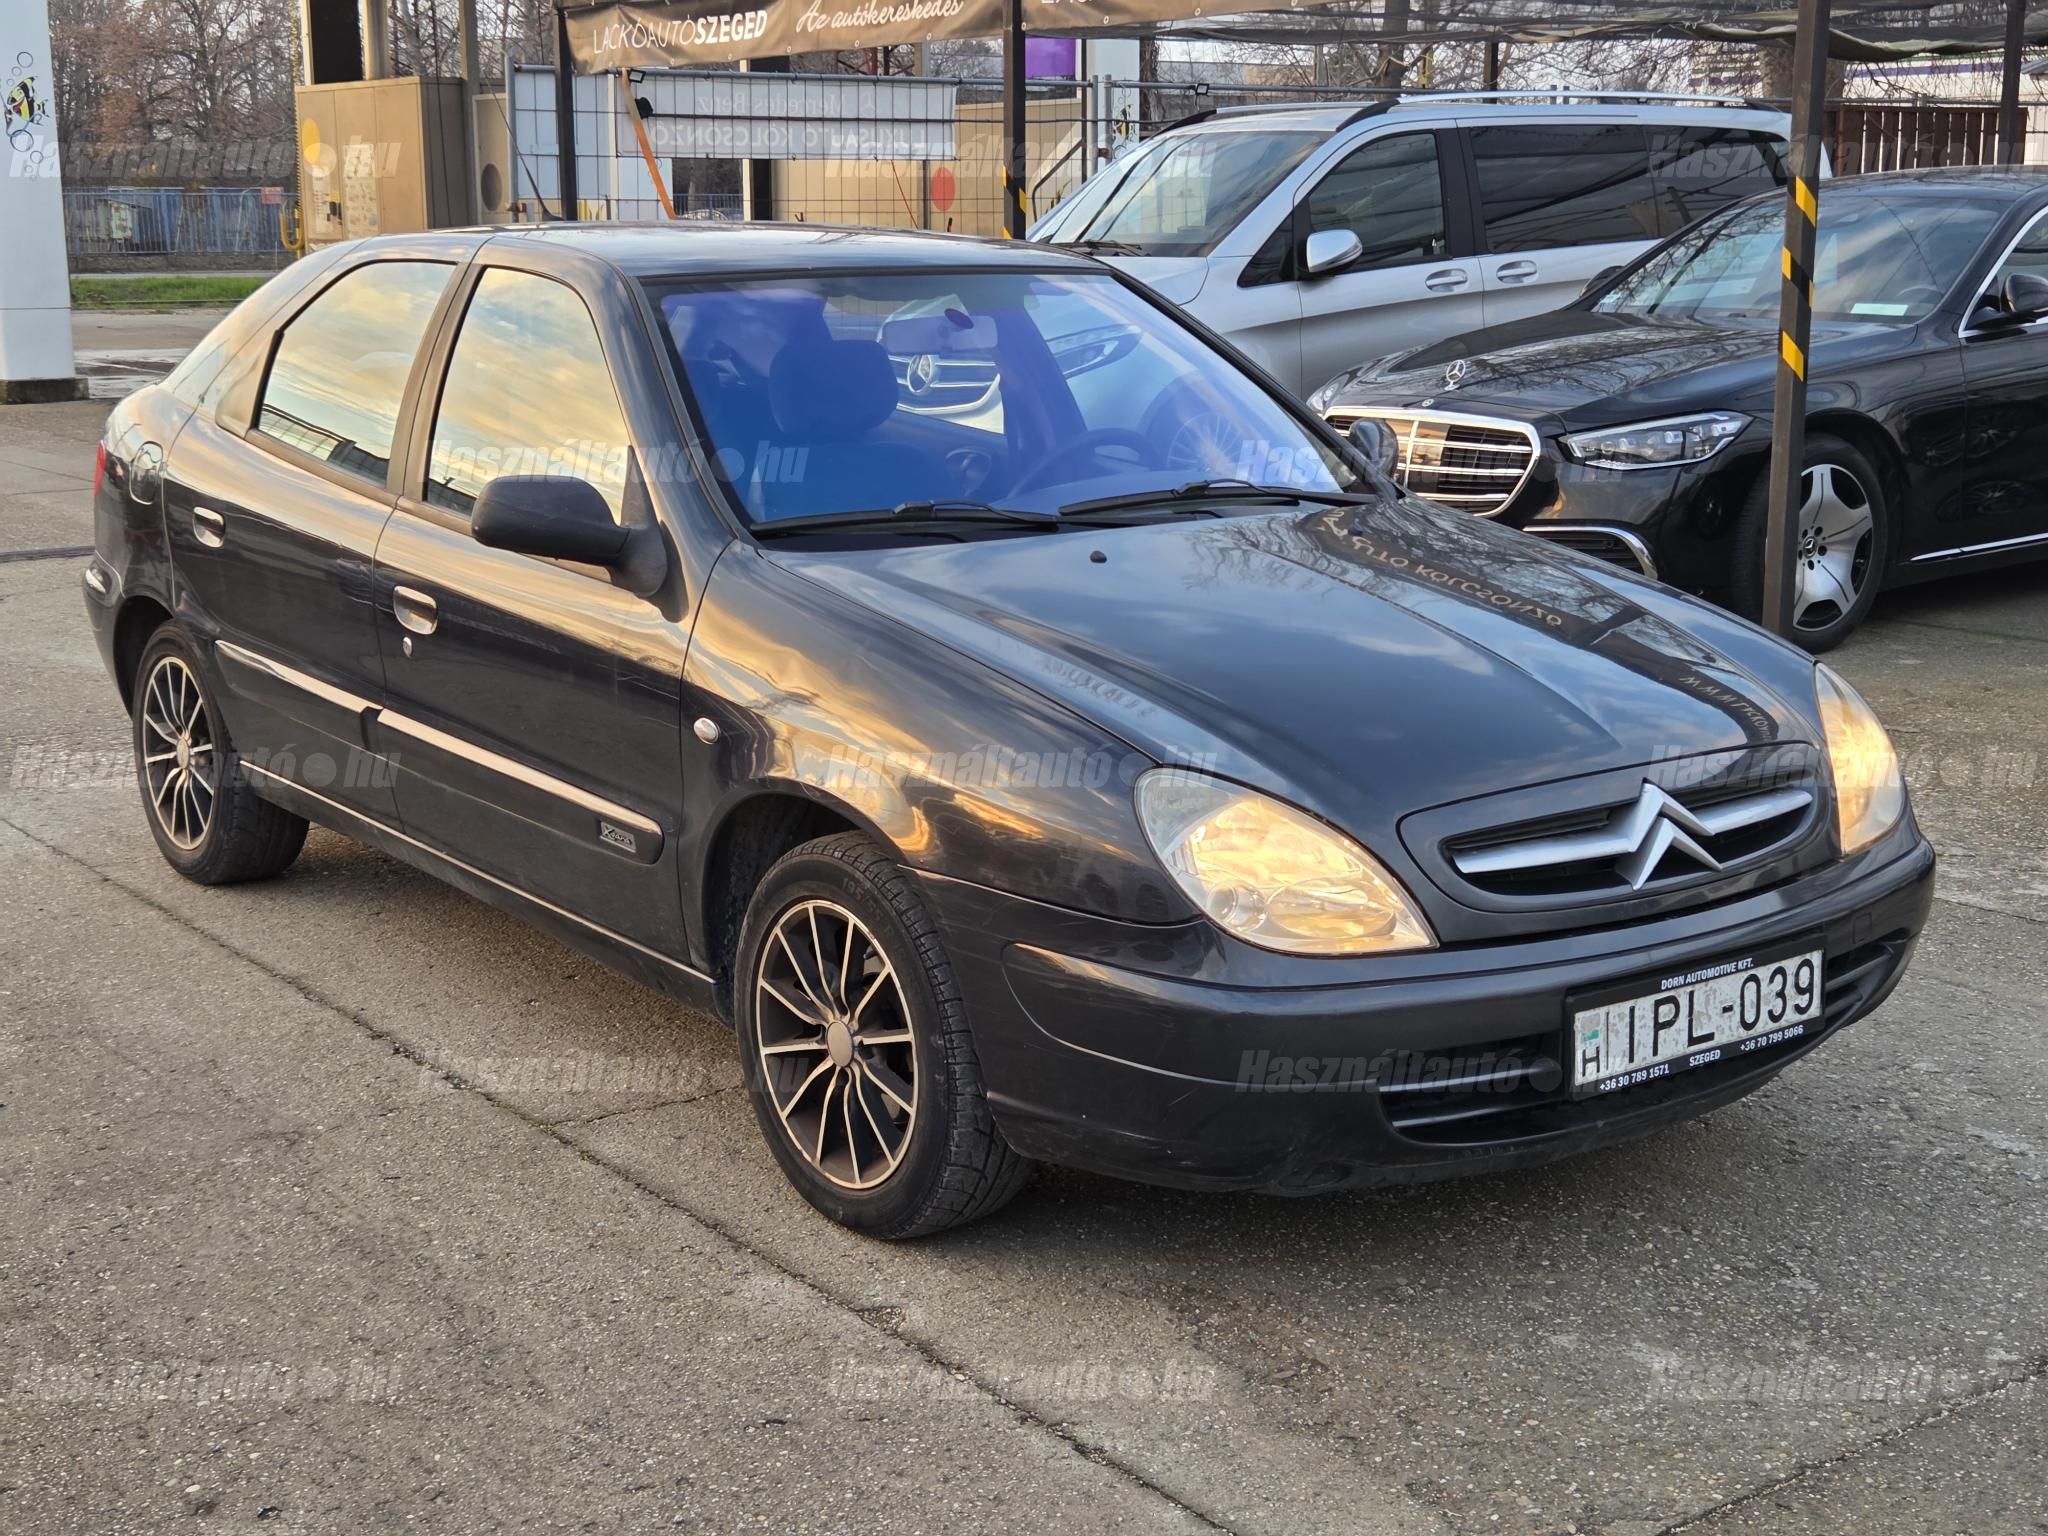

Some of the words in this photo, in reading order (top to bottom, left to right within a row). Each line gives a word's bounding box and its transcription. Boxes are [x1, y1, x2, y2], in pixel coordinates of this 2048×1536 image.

[593, 10, 768, 54] LACKÓAUTÓSZEGED
[796, 0, 831, 33] Az
[1661, 974, 1685, 990] DORN
[1685, 961, 1737, 984] AUTOMOTIVE
[1737, 957, 1754, 970] KFT.
[1628, 957, 1815, 1064] IPL-039
[1689, 1049, 1721, 1067] SZEGED
[1740, 1039, 1755, 1051] +36
[1757, 1036, 1767, 1047] 70
[1582, 1046, 1600, 1078] H
[1600, 1079, 1617, 1091] +36
[1617, 1075, 1629, 1087] 30
[1631, 1070, 1647, 1084] 789
[1649, 1063, 1669, 1079] 1571
